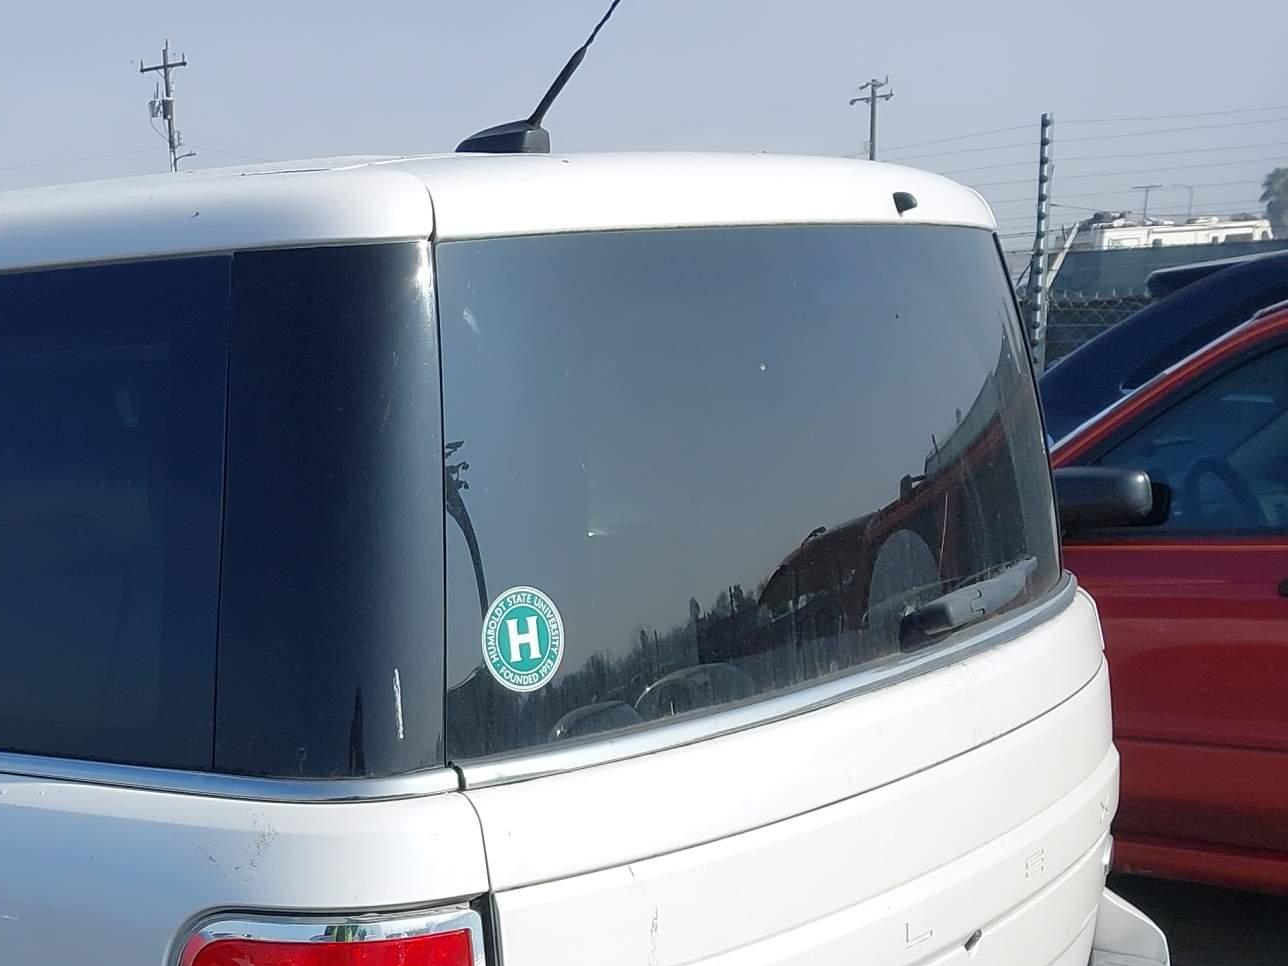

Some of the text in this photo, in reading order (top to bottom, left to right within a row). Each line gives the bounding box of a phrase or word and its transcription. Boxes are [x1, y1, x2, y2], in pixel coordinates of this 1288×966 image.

[485, 592, 560, 664] HUMBOLDT STATE UNIVERSITY
[505, 615, 542, 663] H
[499, 660, 554, 685] FOUNDED 1913
